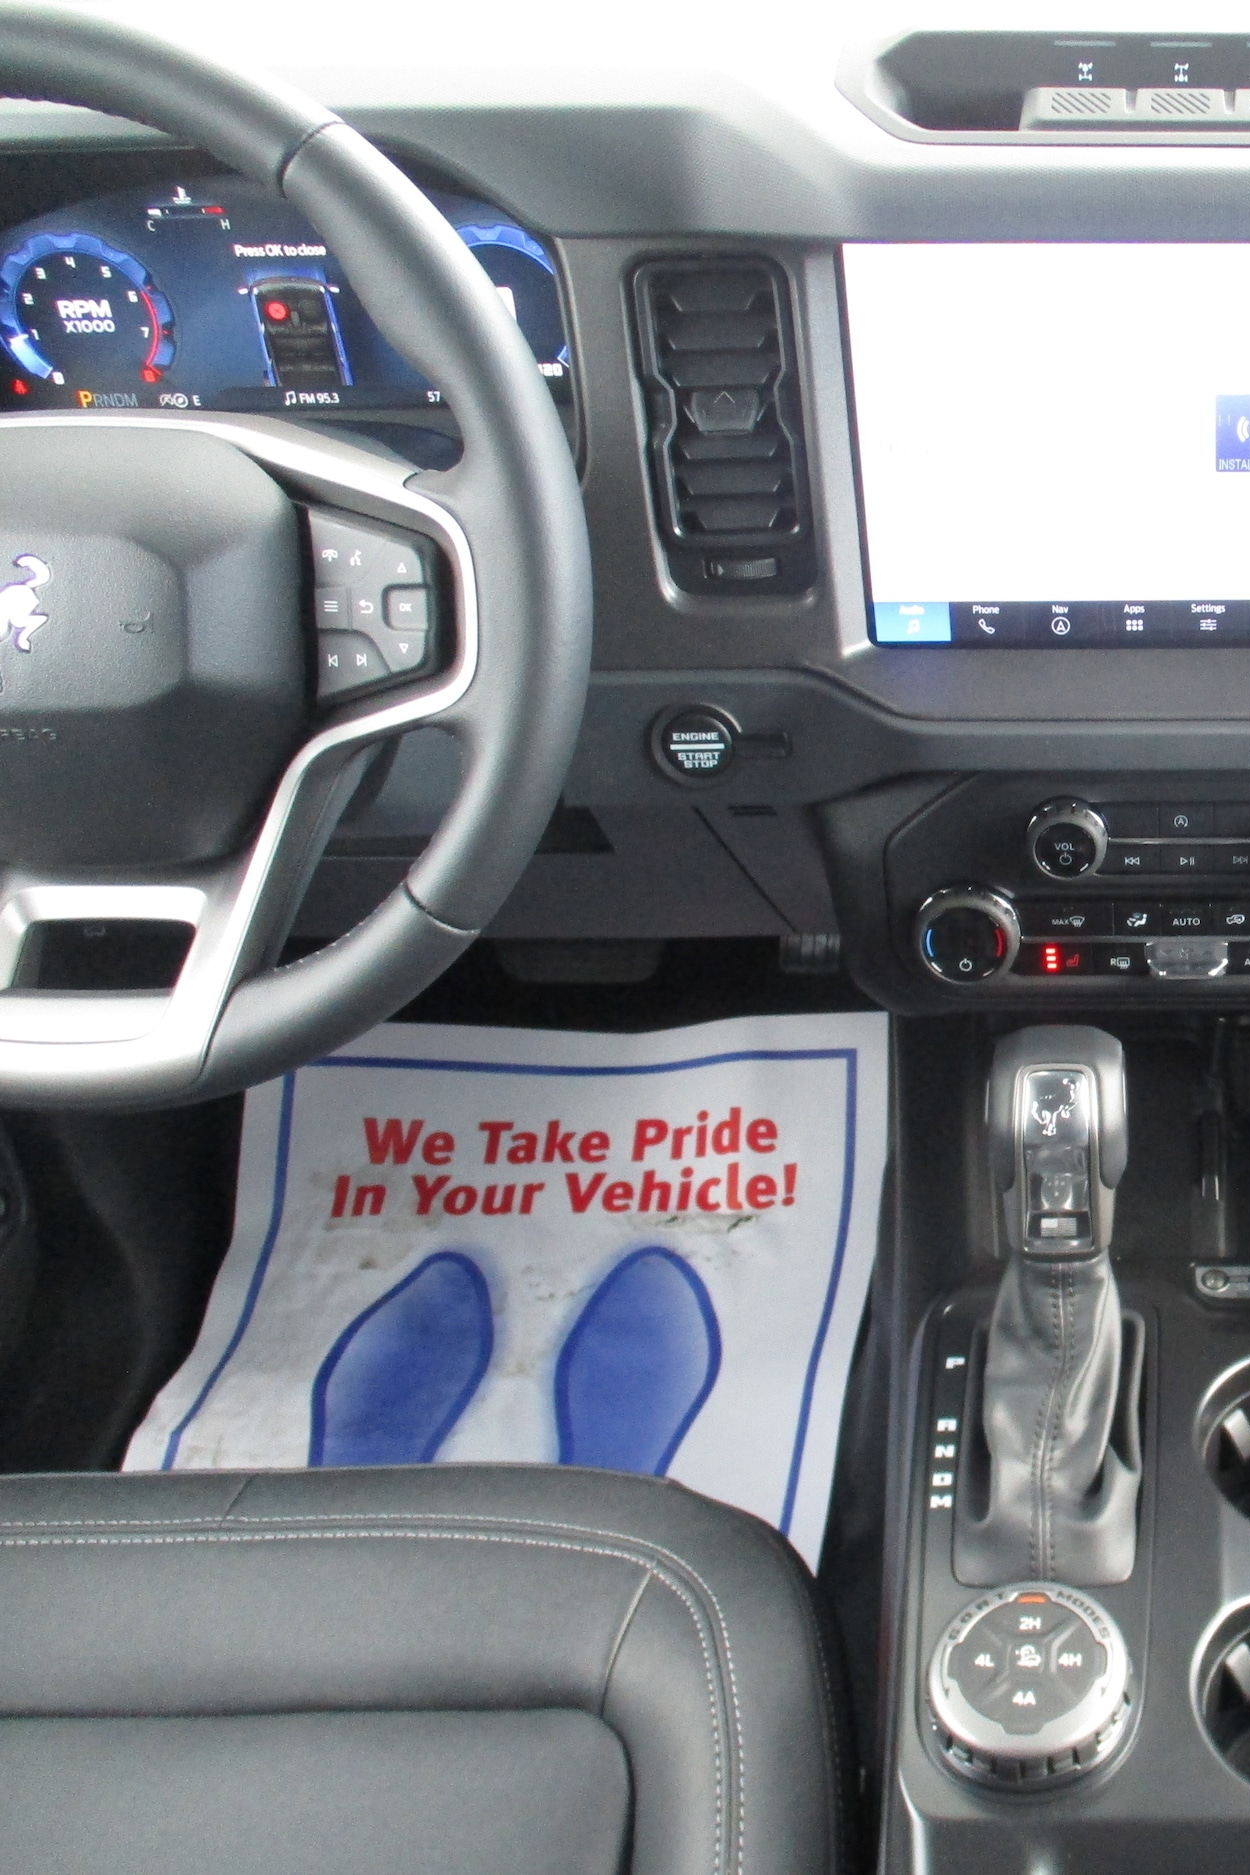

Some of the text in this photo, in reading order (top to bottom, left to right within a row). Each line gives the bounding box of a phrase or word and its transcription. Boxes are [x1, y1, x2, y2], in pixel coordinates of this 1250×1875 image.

[147, 219, 156, 232] C
[220, 218, 231, 231] H
[234, 243, 327, 258] Press OK to close
[65, 256, 76, 269] 4
[35, 267, 47, 280] 3
[101, 266, 112, 278] 5
[22, 292, 34, 305] 2
[127, 290, 138, 303] 6
[56, 299, 113, 319] RPM
[64, 320, 116, 333] X1000
[140, 326, 150, 339] 7
[31, 328, 40, 340] 1
[52, 371, 65, 385] 0
[299, 392, 340, 404] FM 95.3
[427, 391, 441, 403] 57
[399, 602, 412, 612] OK
[972, 604, 1000, 615] Phone
[1051, 604, 1069, 614] Nav
[1123, 603, 1145, 614] Apps
[1191, 603, 1226, 614] Settings
[672, 732, 720, 741] ENGINE
[677, 752, 720, 761] START
[683, 760, 718, 769] STOP
[1054, 842, 1075, 851] VOL
[1172, 918, 1201, 926] AUTO
[364, 1107, 778, 1166] We Take Pride
[331, 1162, 798, 1218] In Your Vehicle!
[945, 1356, 966, 1370] P
[937, 1418, 957, 1432] R
[934, 1444, 955, 1458] N
[932, 1472, 953, 1486] D
[929, 1494, 953, 1509] M
[1056, 1590, 1111, 1639] MODES
[1019, 1616, 1042, 1630] 2H
[974, 1653, 995, 1667] 4L
[1058, 1652, 1083, 1667] 4H
[1012, 1690, 1037, 1706] 4A
